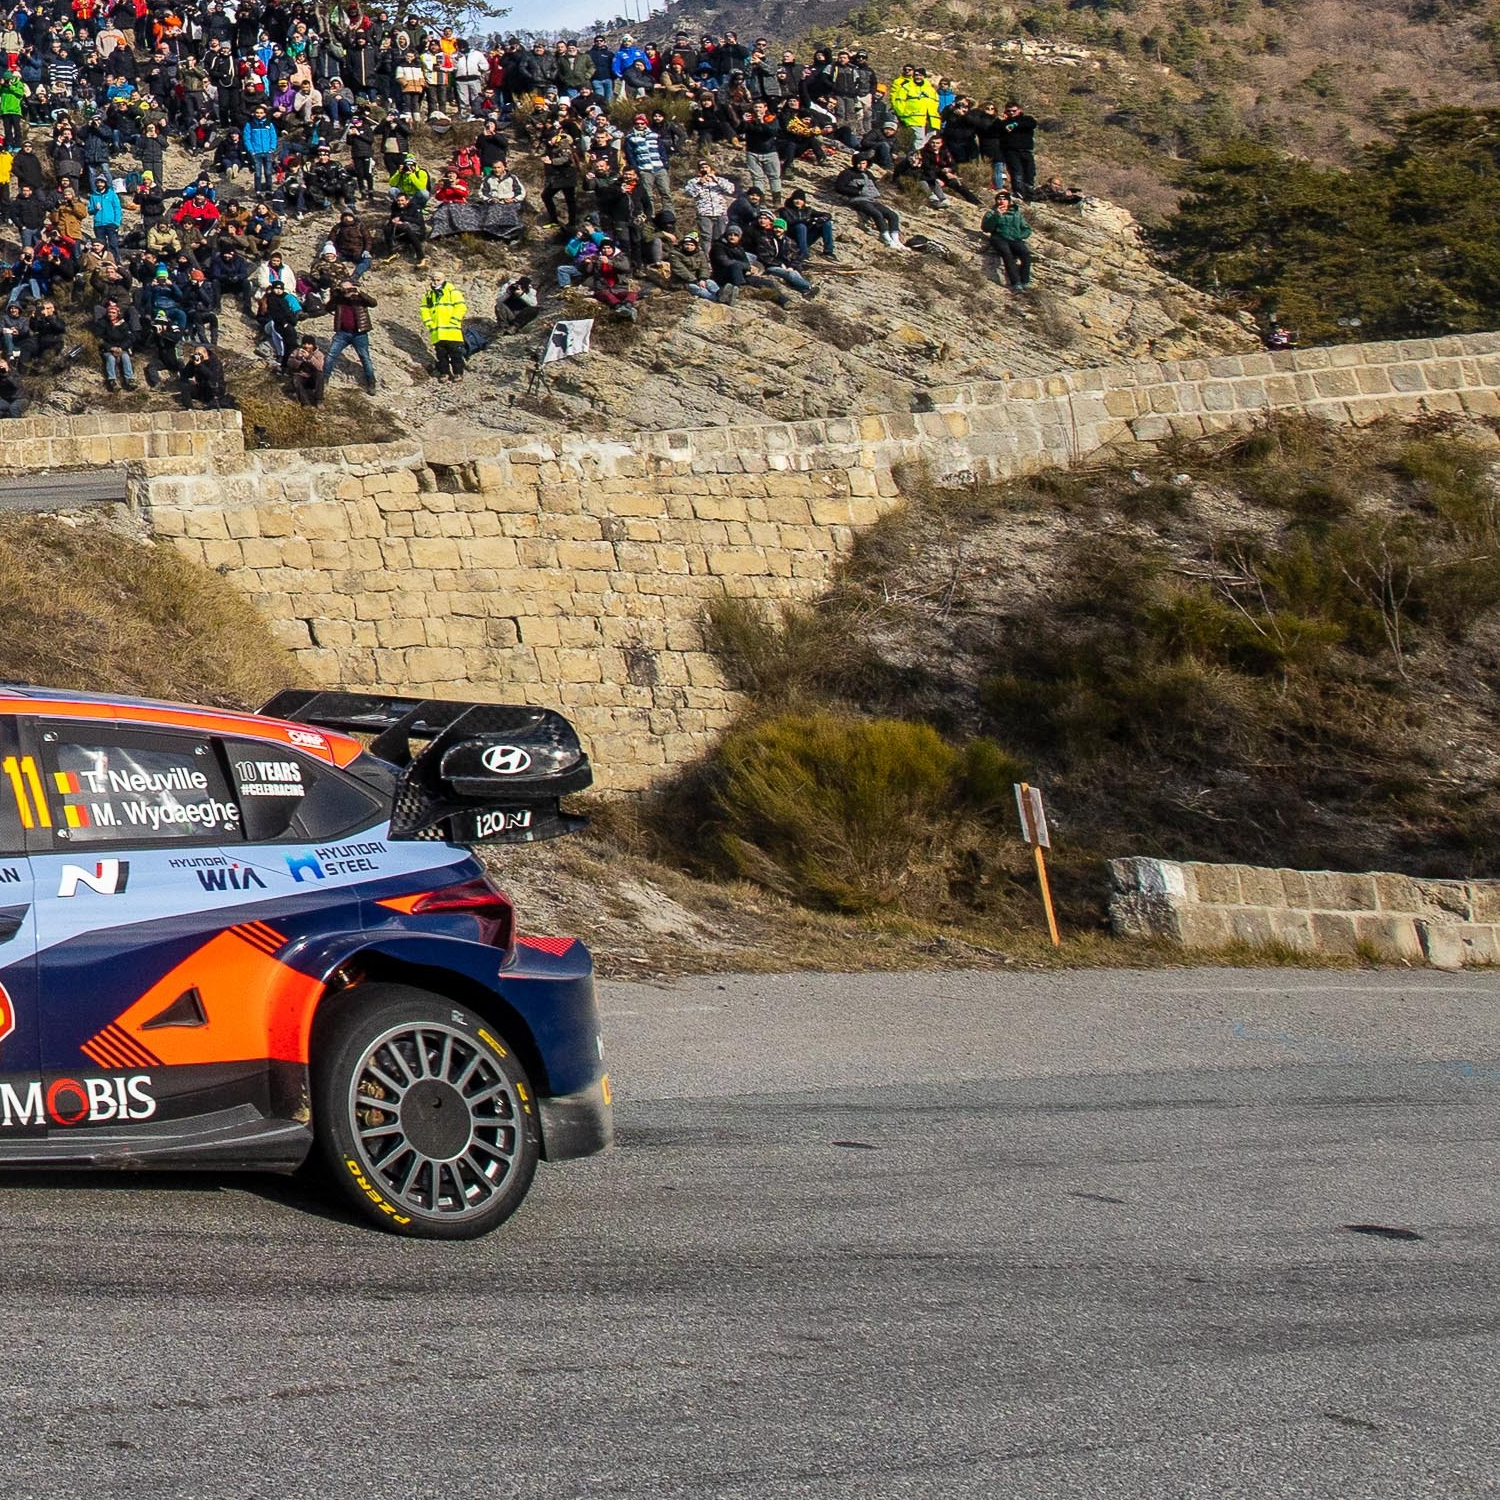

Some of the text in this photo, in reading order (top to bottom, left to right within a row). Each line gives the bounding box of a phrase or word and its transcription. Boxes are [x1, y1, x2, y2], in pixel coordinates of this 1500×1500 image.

[80, 767, 208, 793] T. Neuville
[235, 760, 302, 782] 10 YEARS
[2, 756, 52, 829] 11
[90, 799, 241, 831] M. Wydaeghe
[315, 841, 387, 860] HYUNDAI
[168, 857, 228, 868] HYUNDAI
[324, 858, 379, 876] STEEL
